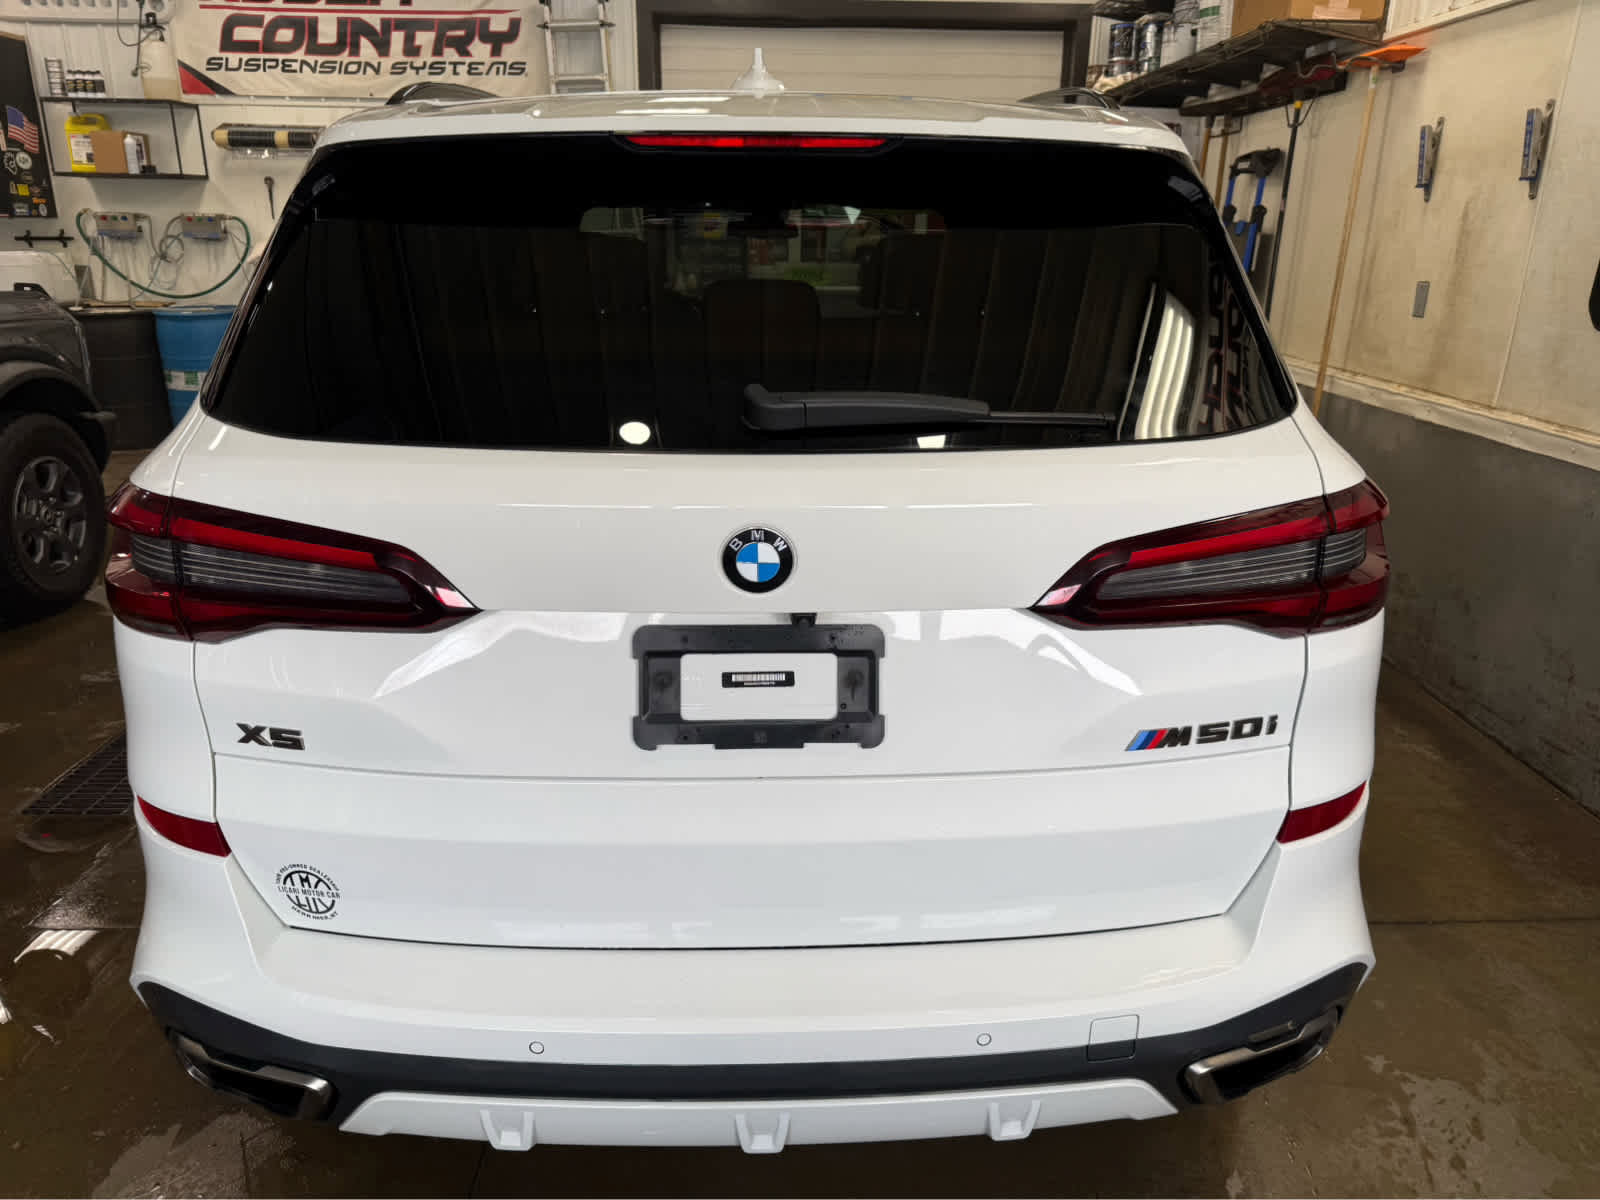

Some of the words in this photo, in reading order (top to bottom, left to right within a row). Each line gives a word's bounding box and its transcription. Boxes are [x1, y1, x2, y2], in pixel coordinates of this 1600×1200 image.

[219, 13, 522, 58] COUNTRY
[205, 56, 381, 75] SUSPENSION
[729, 529, 788, 552] BMW
[236, 722, 305, 751] X5
[301, 888, 325, 898] MOTOR
[326, 891, 341, 899] CAR
